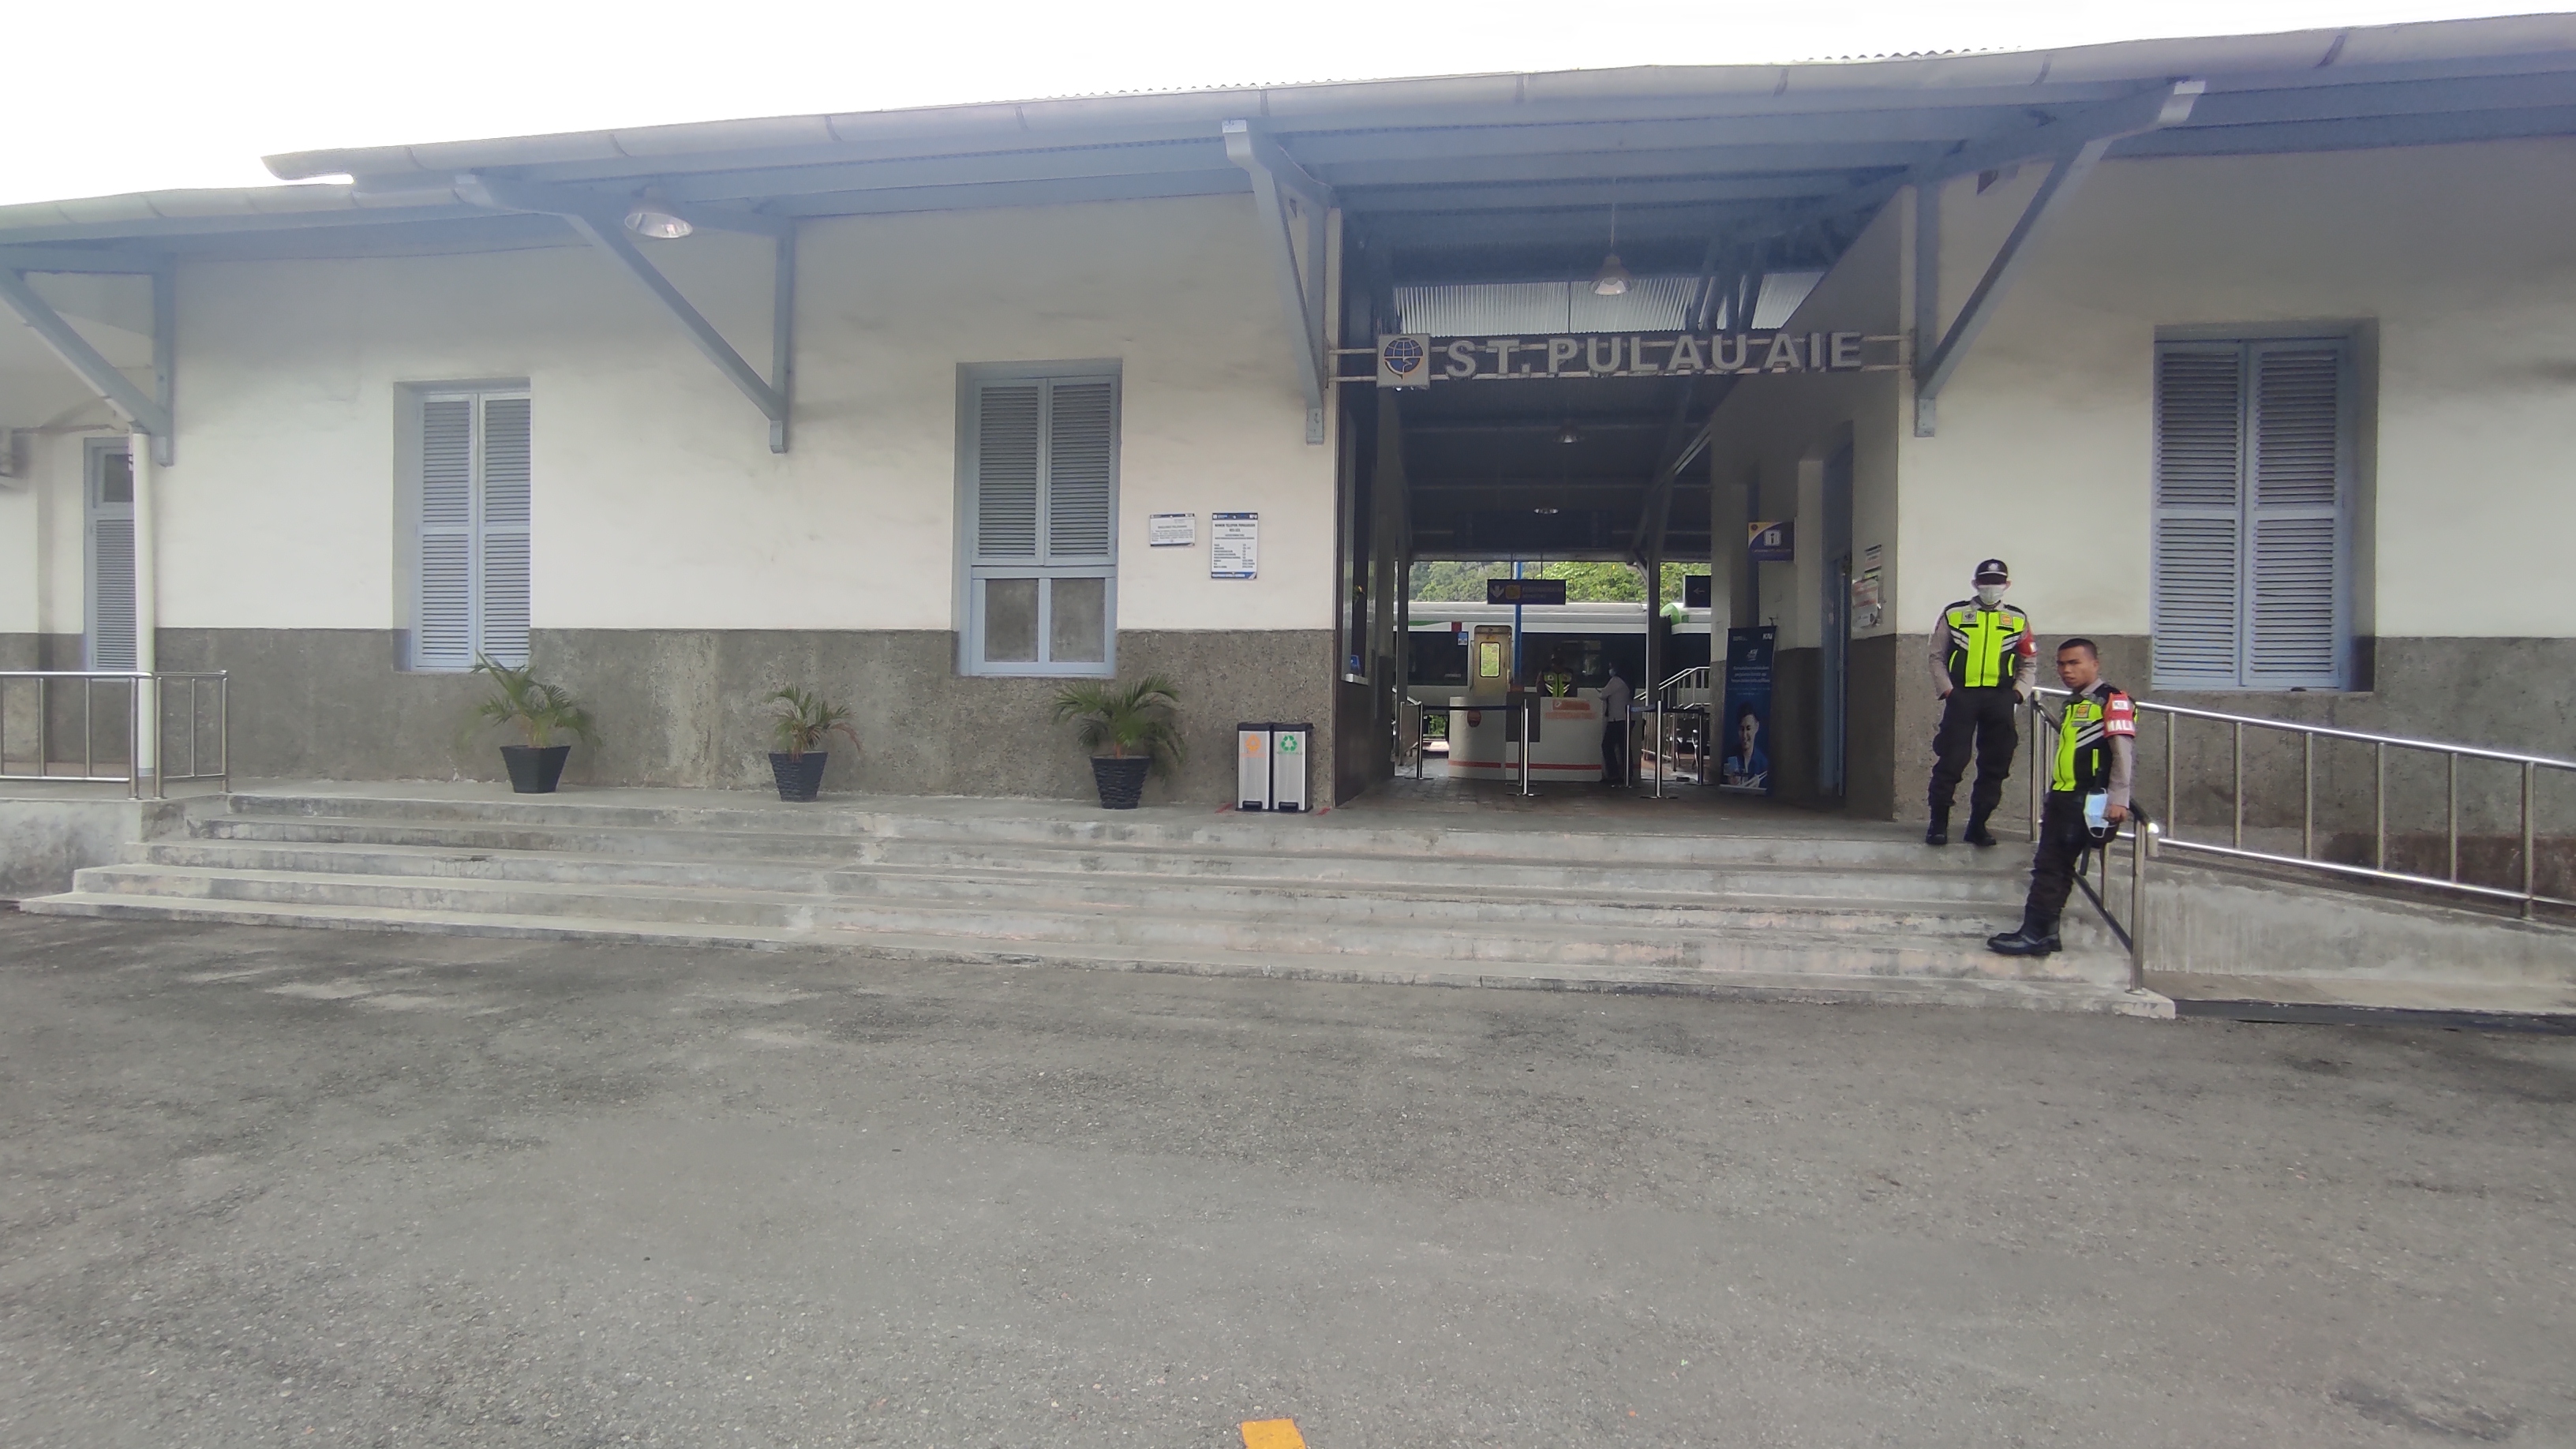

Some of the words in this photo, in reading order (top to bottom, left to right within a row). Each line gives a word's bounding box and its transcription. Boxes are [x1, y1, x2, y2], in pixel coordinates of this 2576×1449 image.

[1445, 339, 1531, 380] ST.
[1548, 333, 1747, 376] PULAU
[1764, 331, 1863, 370] AIE
